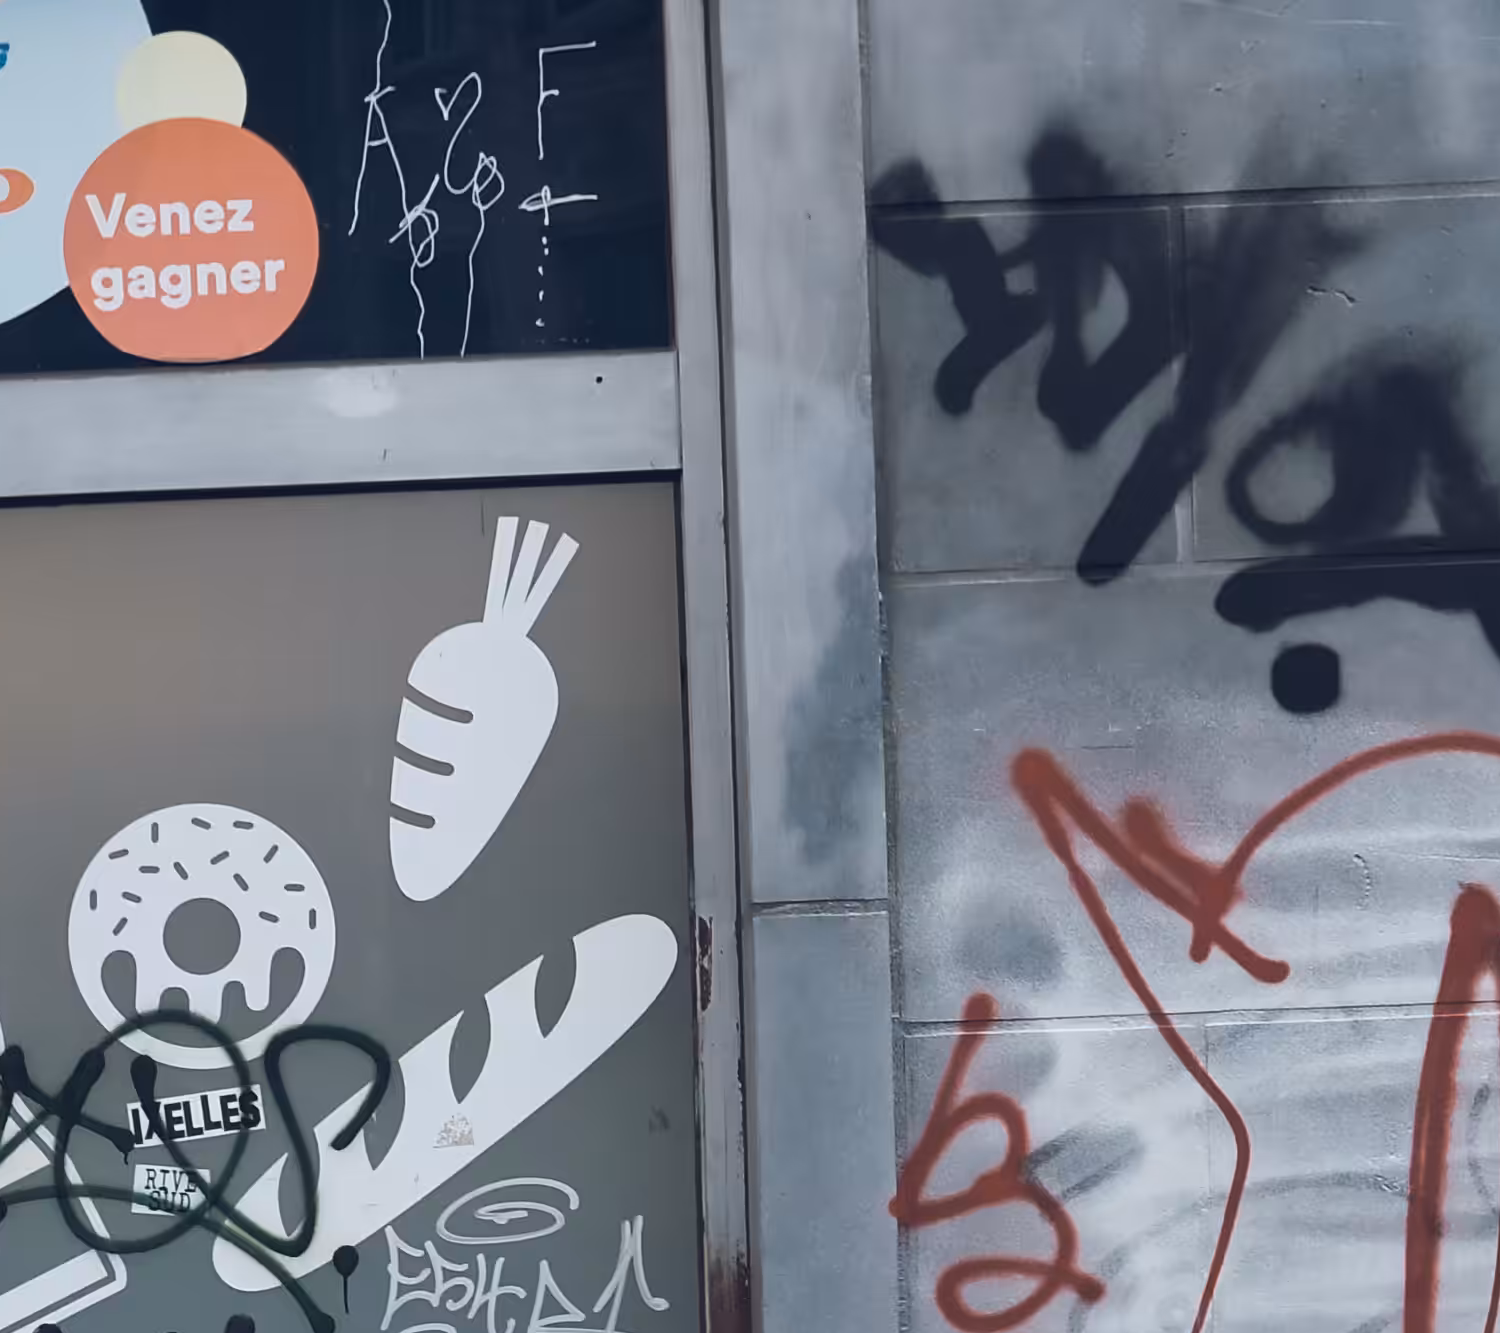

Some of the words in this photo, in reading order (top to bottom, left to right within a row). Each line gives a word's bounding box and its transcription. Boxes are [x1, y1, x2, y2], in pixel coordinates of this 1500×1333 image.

[85, 192, 255, 239] Venez
[90, 258, 286, 312] gagner
[131, 1090, 262, 1145] IXELLES
[144, 1168, 199, 1193] RIVE
[149, 1187, 192, 1213] SUD
